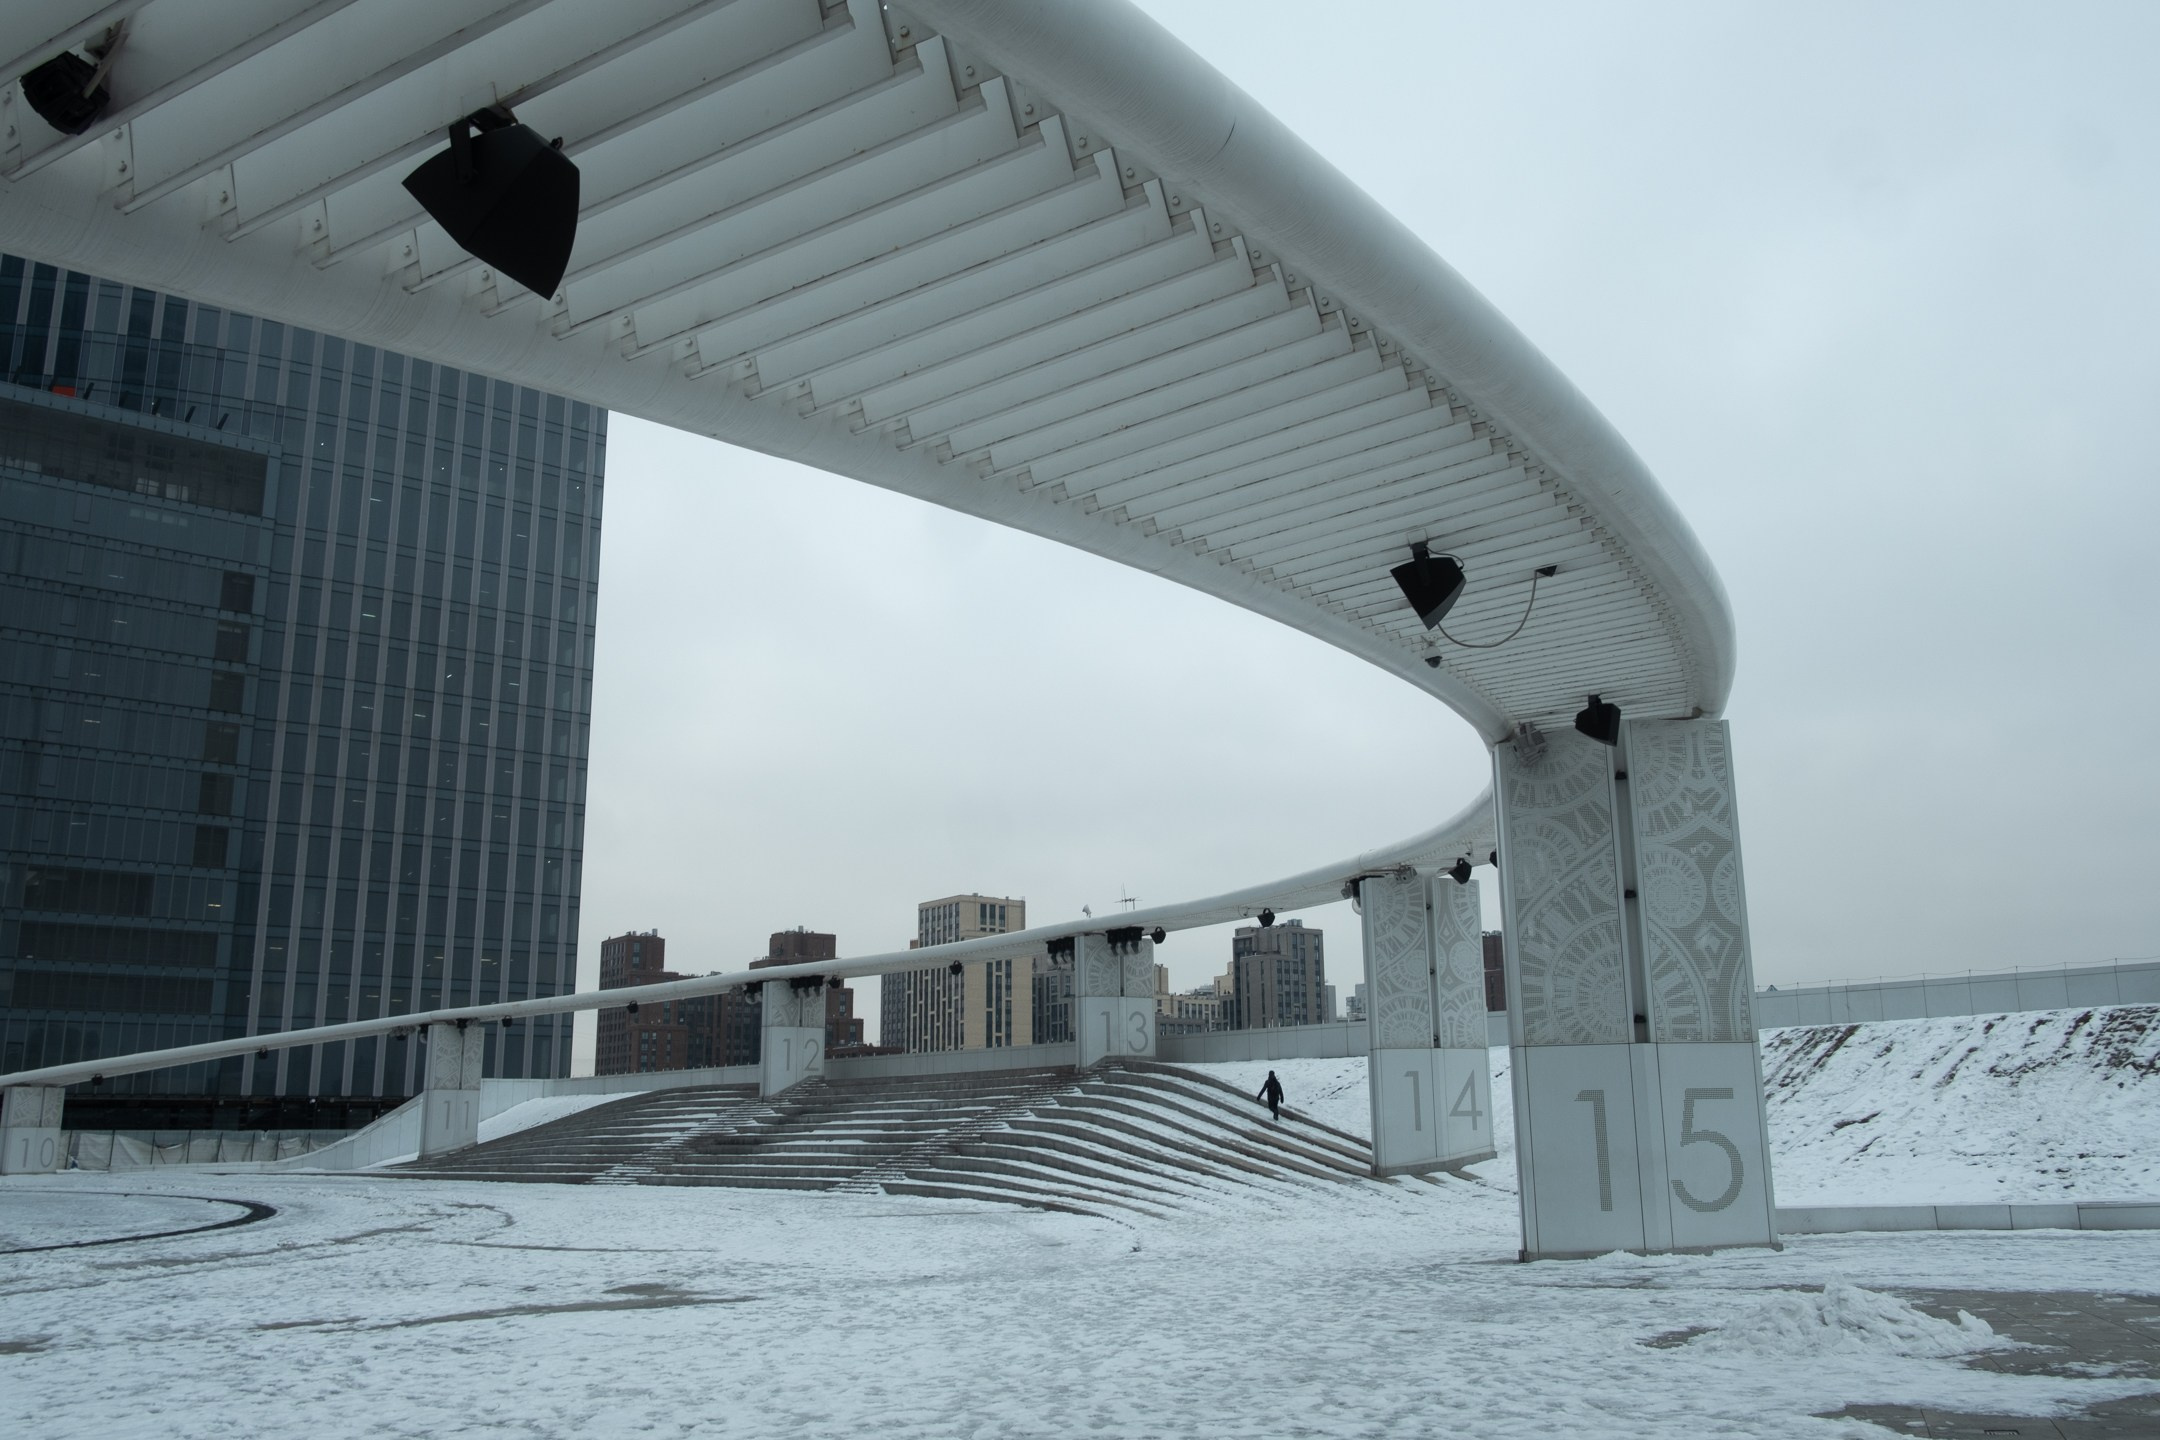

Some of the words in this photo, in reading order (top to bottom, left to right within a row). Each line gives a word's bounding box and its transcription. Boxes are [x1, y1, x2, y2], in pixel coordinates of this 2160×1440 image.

[1101, 1011, 1148, 1052] 13
[782, 1039, 819, 1071] 12
[443, 1100, 470, 1130] 11
[1404, 1069, 1482, 1131] 14
[21, 1136, 55, 1168] 10
[1575, 1087, 1744, 1212] 15
